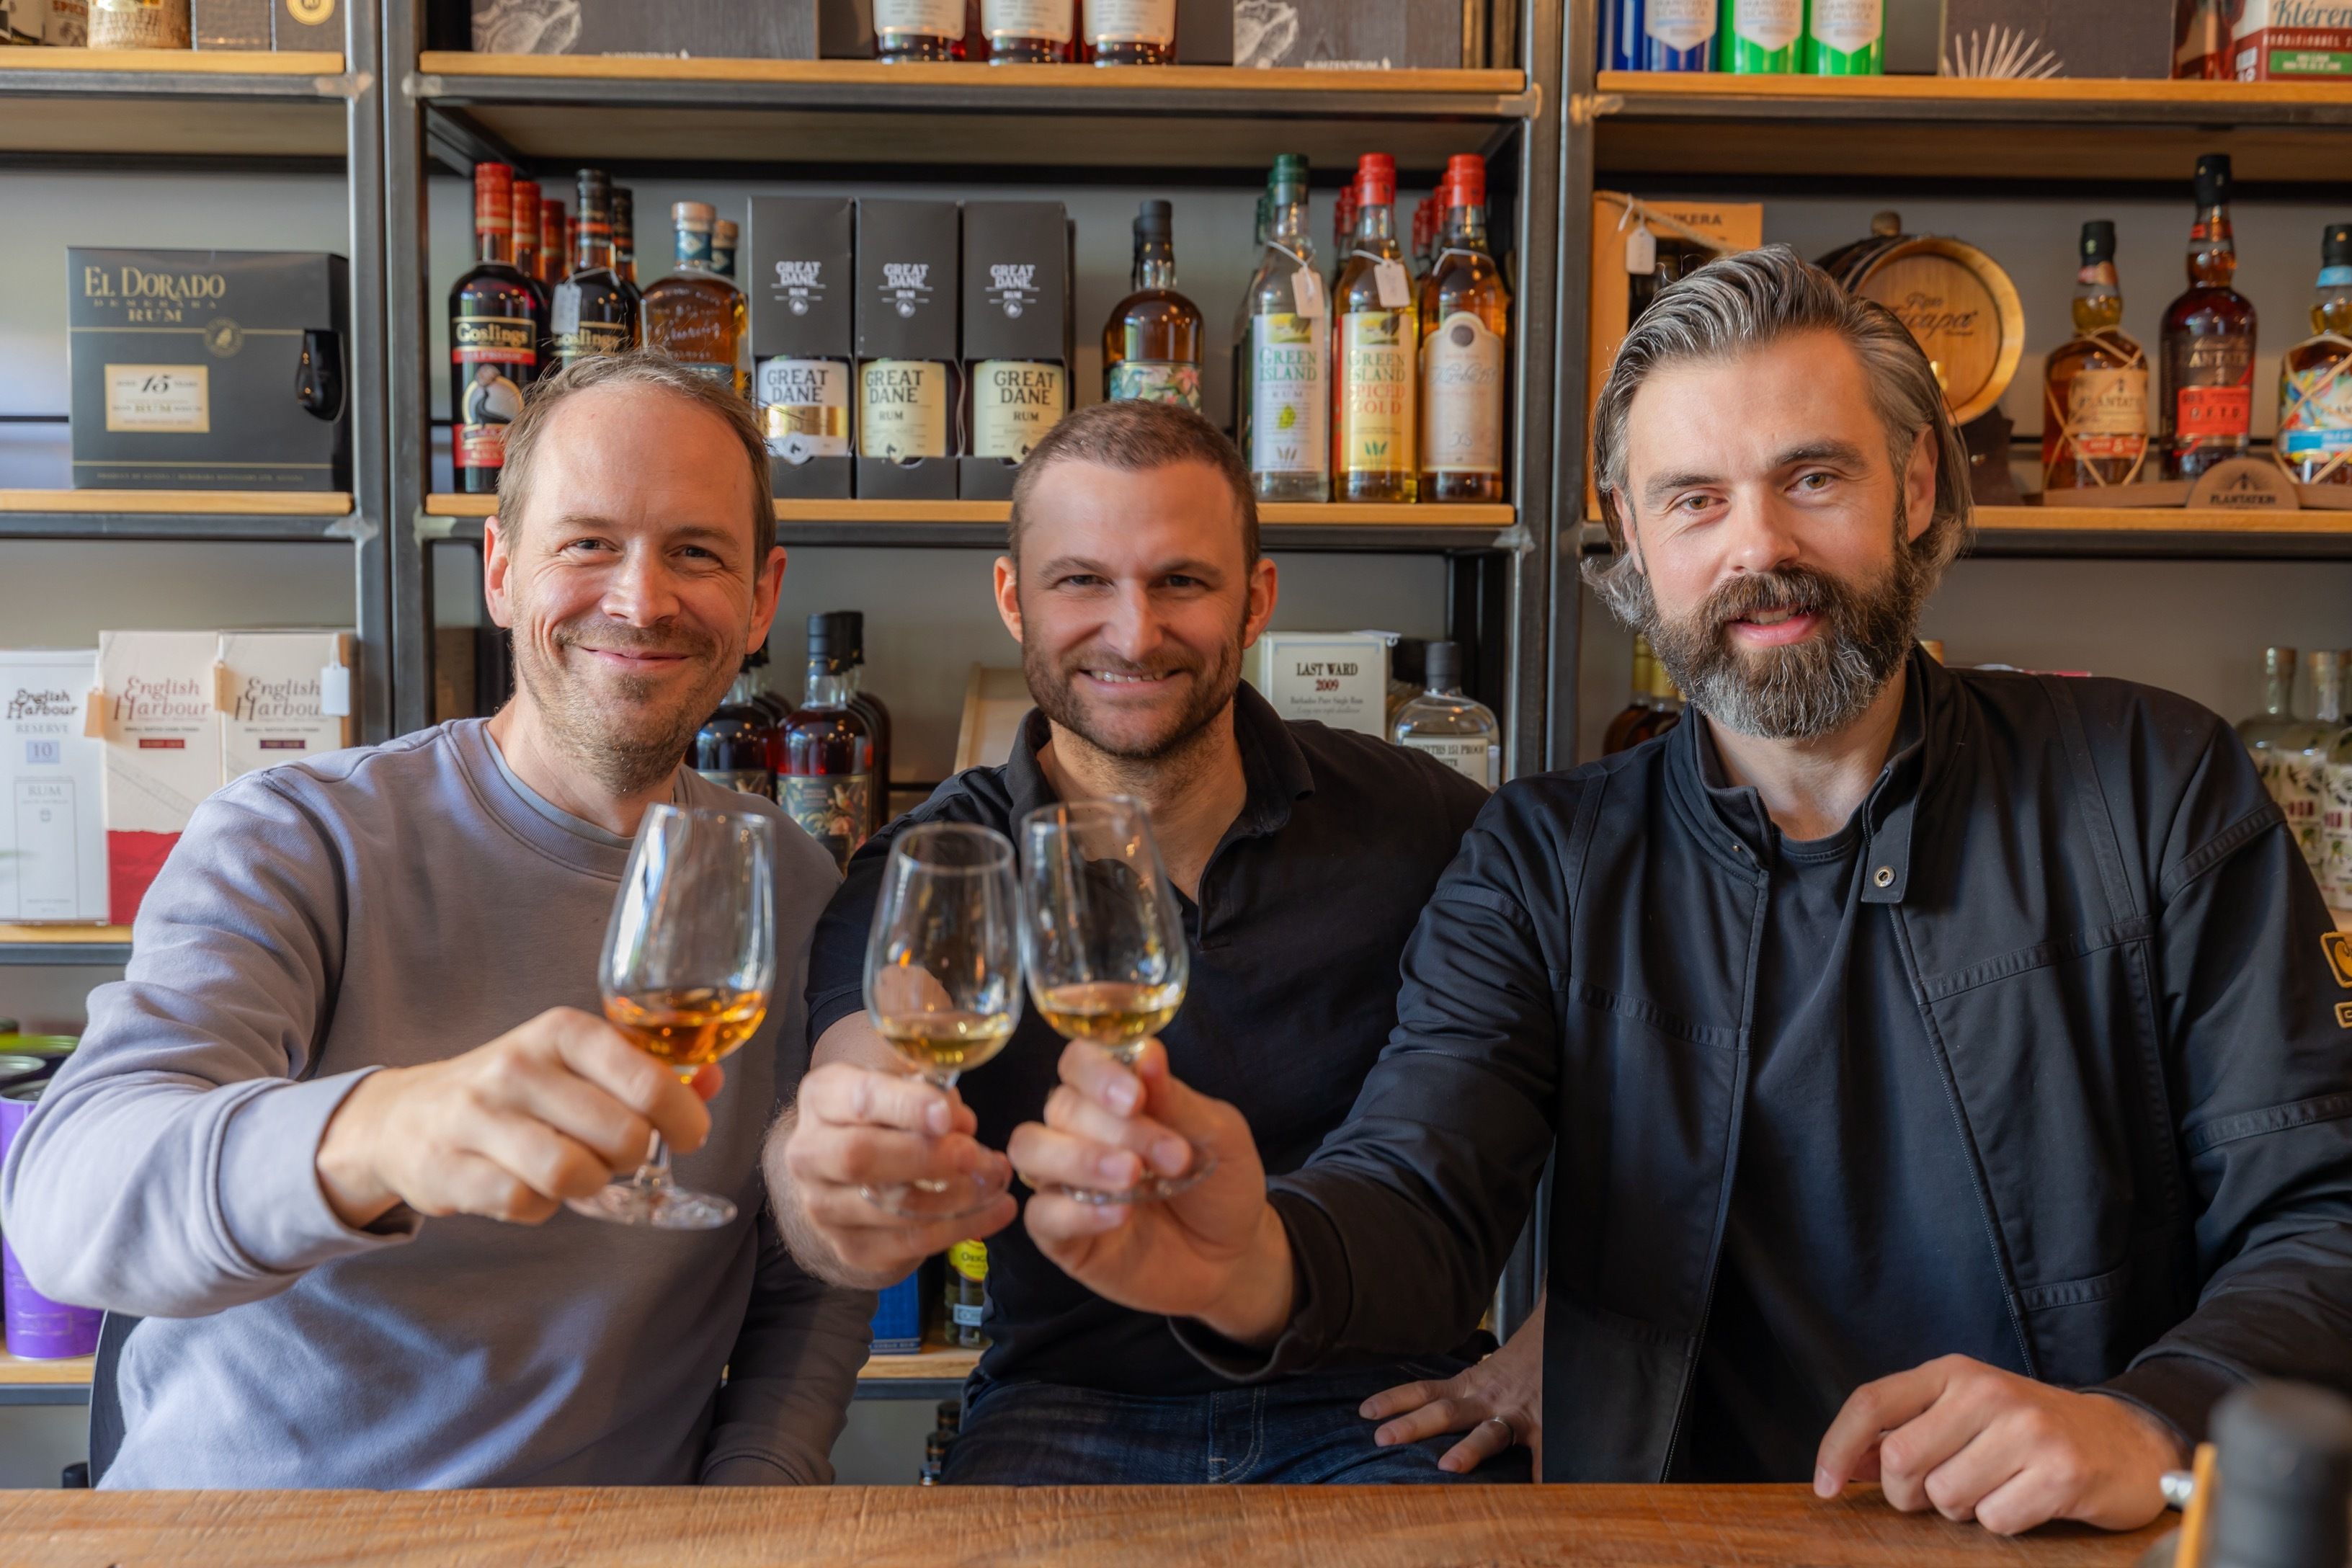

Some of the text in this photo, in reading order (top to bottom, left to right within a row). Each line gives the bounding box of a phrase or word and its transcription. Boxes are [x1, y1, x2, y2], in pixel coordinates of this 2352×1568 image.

[775, 261, 821, 275] GREAT
[883, 263, 930, 277] GREAT
[990, 264, 1036, 278] GREAT
[121, 266, 226, 302] DORADO
[780, 273, 818, 287] DANE
[888, 275, 925, 289] DANE
[995, 277, 1032, 290] DANE
[128, 308, 182, 323] RUM
[455, 323, 529, 347] Goslings
[1259, 347, 1317, 365] GREEN
[1348, 349, 1405, 366] GREEN
[767, 368, 829, 386] GREAT
[865, 369, 925, 387] GREAT
[994, 370, 1055, 388] GREAT
[1260, 366, 1317, 382] ISLAND
[141, 373, 172, 395] 15
[772, 386, 823, 403] DANE
[870, 387, 919, 404] DANE
[1000, 388, 1051, 405] DANE
[879, 411, 904, 420] RUM
[1013, 411, 1039, 422] RUM
[1296, 662, 1358, 676] LAST WARD
[125, 675, 200, 700] English
[245, 675, 321, 701] English
[1315, 679, 1340, 692] 2009
[15, 689, 70, 706] English
[6, 700, 78, 719] Harbour
[114, 695, 210, 721] Harbour
[234, 695, 321, 721] Harbou
[33, 742, 53, 758] 10
